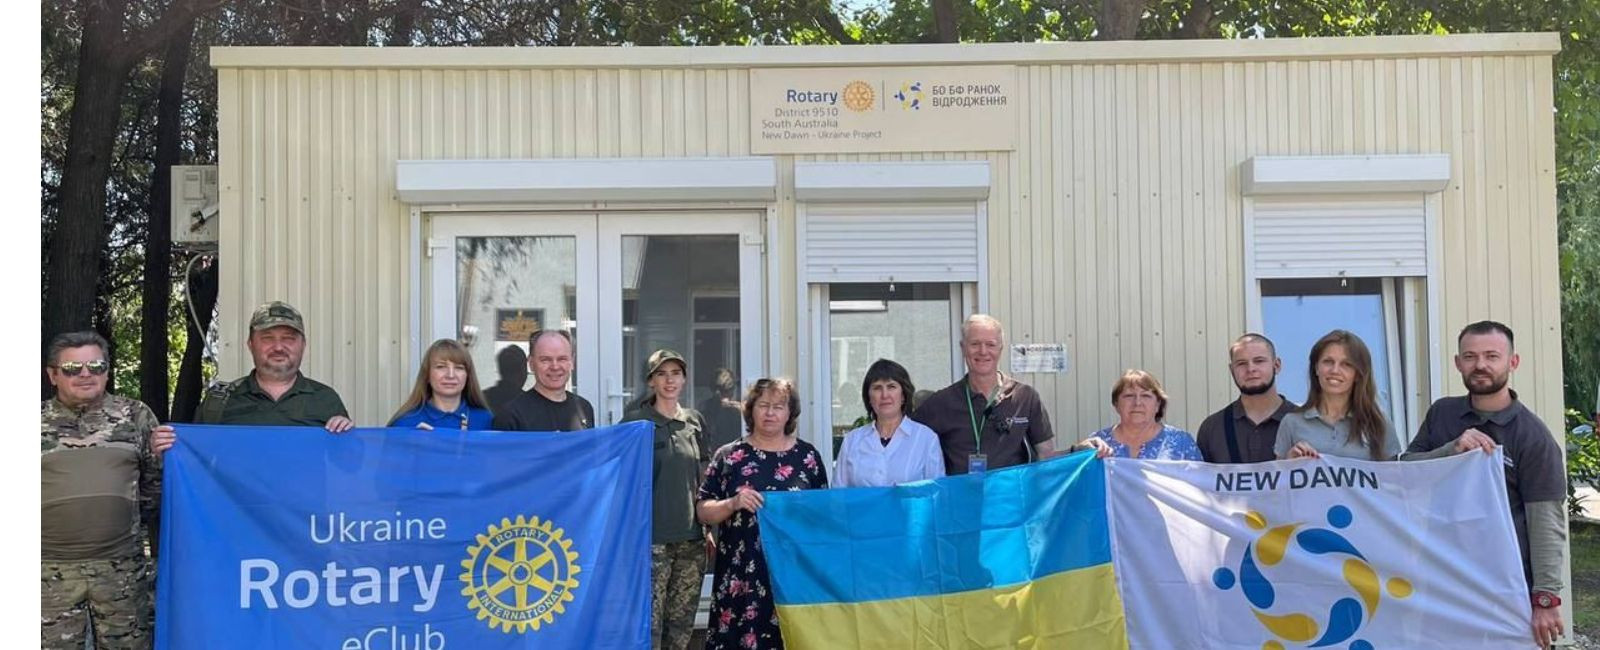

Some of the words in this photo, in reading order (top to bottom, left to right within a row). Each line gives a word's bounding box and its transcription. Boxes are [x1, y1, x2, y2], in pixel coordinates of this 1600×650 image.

[787, 89, 838, 105] Rotary
[932, 86, 946, 95] БО
[949, 85, 965, 95] БФ
[968, 84, 1001, 95] РАНОК
[932, 96, 1007, 107] ВІДРОДЖЕННЯ
[775, 107, 810, 117] District
[812, 107, 839, 117] 9510
[762, 119, 791, 129] South
[794, 119, 838, 128] Australia
[762, 131, 782, 140] New
[784, 131, 809, 139] Dawn
[818, 130, 851, 139] Ukraine
[853, 130, 882, 140] Project
[1215, 471, 1281, 492] NEW
[1289, 466, 1379, 490] DAWN
[309, 511, 447, 544] Ukraine
[495, 528, 544, 543] ROTARY
[239, 558, 445, 612] Rotary
[480, 588, 563, 620] INTERNATIONAL
[341, 623, 446, 650] eClub
